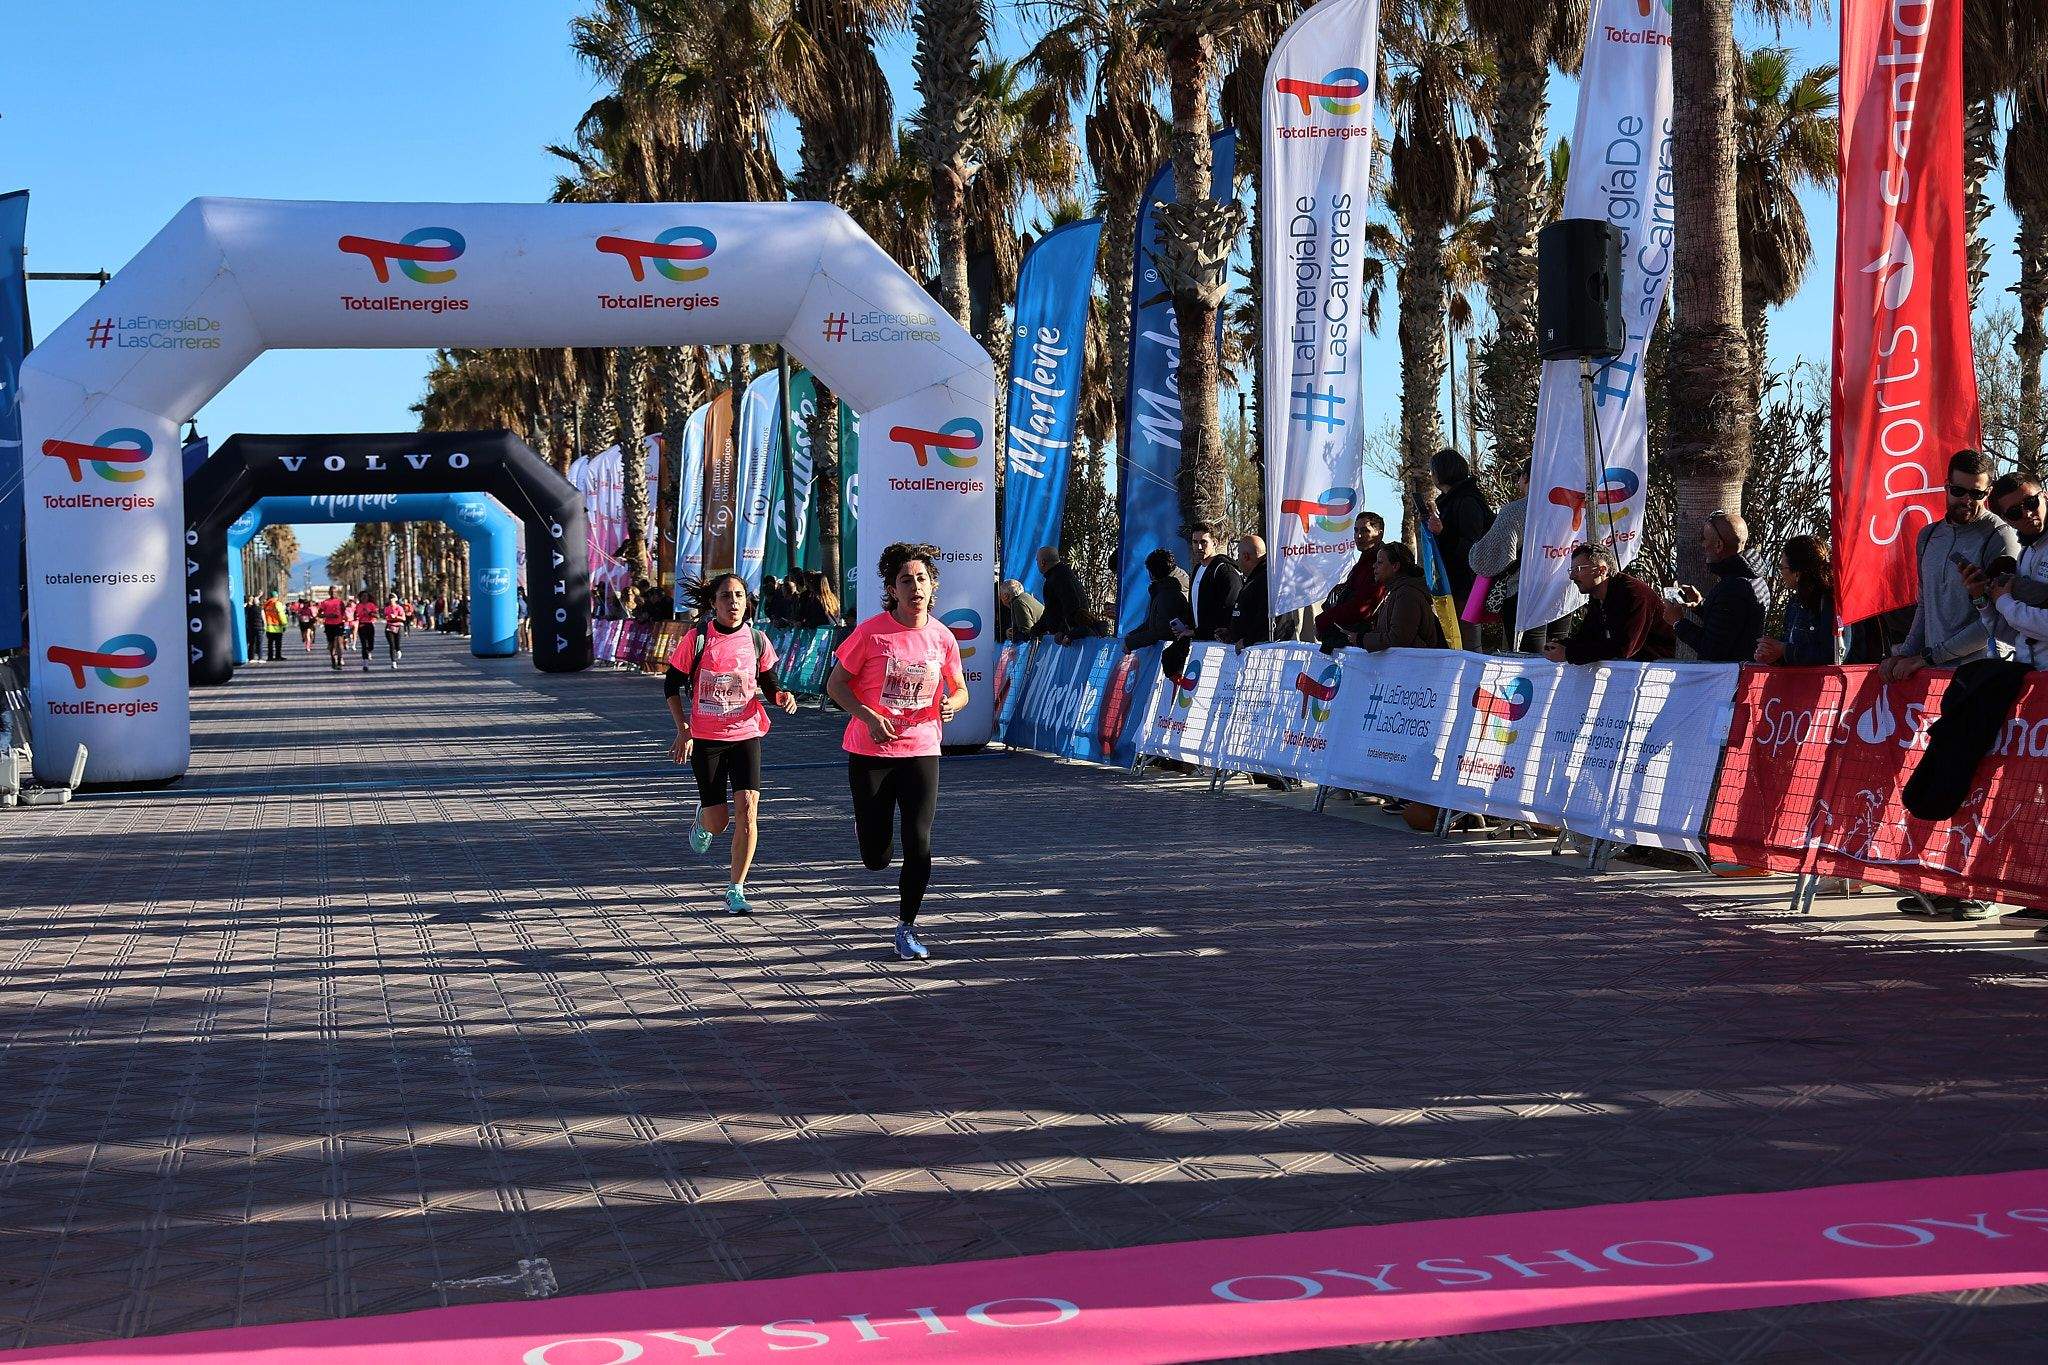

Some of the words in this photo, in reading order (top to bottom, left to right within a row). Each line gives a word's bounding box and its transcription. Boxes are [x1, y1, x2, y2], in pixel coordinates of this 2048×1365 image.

[1276, 125, 1368, 140] TotalEnergies
[1323, 193, 1351, 375] LasCarreras
[340, 295, 469, 314] TotalEnergies
[597, 293, 720, 311] TotalEnergies
[118, 333, 221, 349] LasCarreras
[851, 327, 941, 342] LasCarreras
[1009, 326, 1069, 479] Marlene
[1868, 325, 1945, 547] Sports
[278, 453, 470, 472] VOLVO
[712, 458, 721, 502] Institutos
[888, 477, 984, 494] TotalEnergies
[43, 494, 155, 511] TotalEnergies
[1281, 539, 1356, 558] TotalEnergie
[45, 571, 156, 586] totalenergies.es
[186, 529, 203, 665] VOLVO
[550, 523, 568, 654] VOLVO
[48, 700, 159, 717] TotalEnergies
[1376, 711, 1431, 738] LasCarreras
[1605, 715, 1613, 728] la
[1755, 697, 1856, 757] Sports
[1455, 755, 1516, 782] TotalEnergies
[1210, 1239, 1715, 1304] OYSHO
[522, 1297, 1080, 1365] OYSHO
